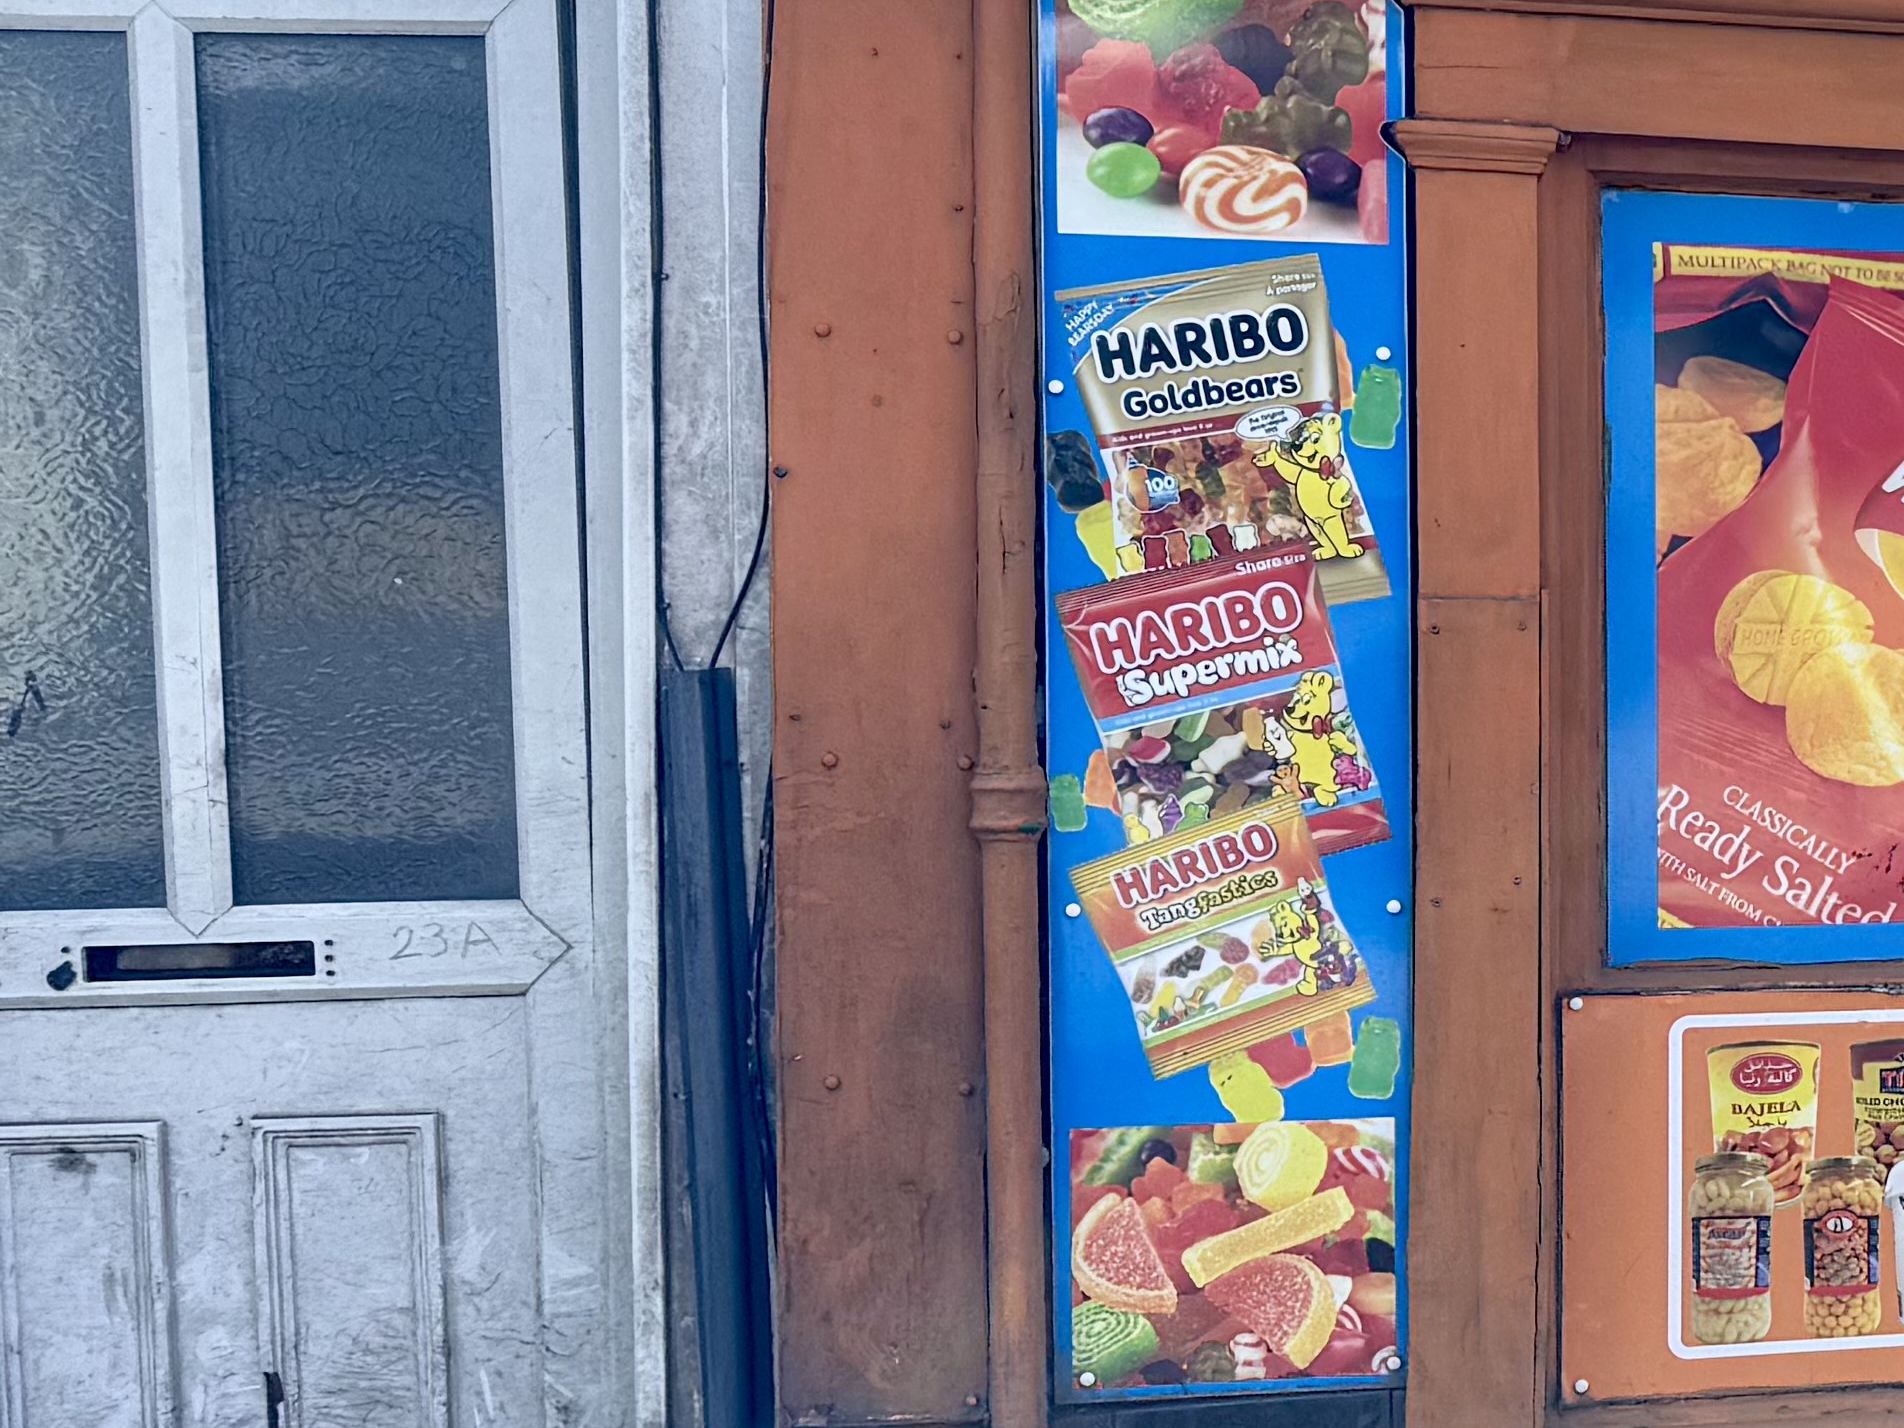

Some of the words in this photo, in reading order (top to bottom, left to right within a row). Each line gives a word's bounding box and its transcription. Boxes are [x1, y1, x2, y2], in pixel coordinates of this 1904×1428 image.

[1677, 253, 1784, 273] MULTIPACK
[1786, 258, 1818, 277] BAG
[1819, 262, 1853, 280] NOT
[1855, 266, 1874, 281] TO
[1094, 307, 1304, 380] HARIBO
[1122, 372, 1299, 418] Goldbears
[1144, 476, 1177, 492] 100
[1235, 558, 1283, 575] Share
[1089, 582, 1303, 673] HARIBO
[1119, 637, 1302, 706] Supermix
[1657, 783, 1765, 881] Ready
[1762, 854, 1898, 925] Salted
[1722, 784, 1858, 875] CLASSICALLY
[1111, 822, 1279, 909] HARIBO
[1686, 867, 1720, 896] SALT
[1719, 886, 1763, 922] FROM
[1140, 870, 1279, 930] Tangfastics
[388, 921, 502, 960] 23A
